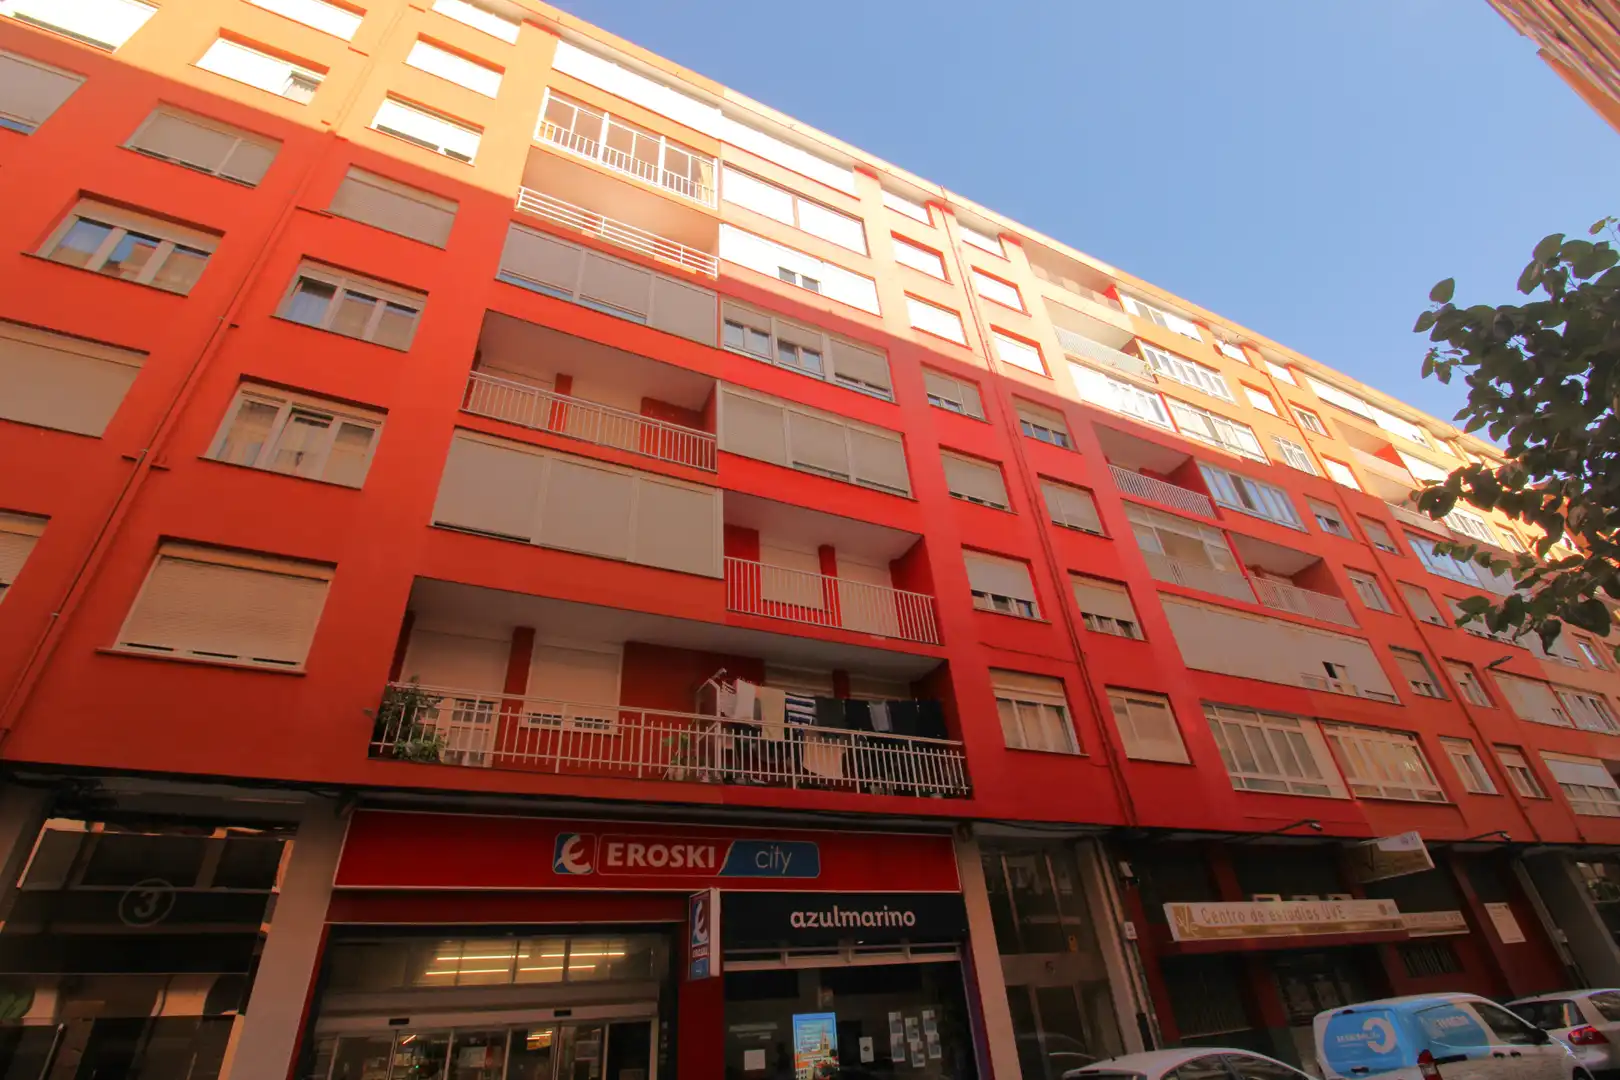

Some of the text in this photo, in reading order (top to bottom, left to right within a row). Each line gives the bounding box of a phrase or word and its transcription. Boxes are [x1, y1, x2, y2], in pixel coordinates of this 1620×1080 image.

[606, 842, 793, 875] EROSKI city
[133, 887, 161, 918] 3
[1200, 907, 1245, 924] Centro
[1250, 907, 1265, 923] de
[1269, 905, 1320, 922] estudios
[790, 905, 917, 929] azulmarino
